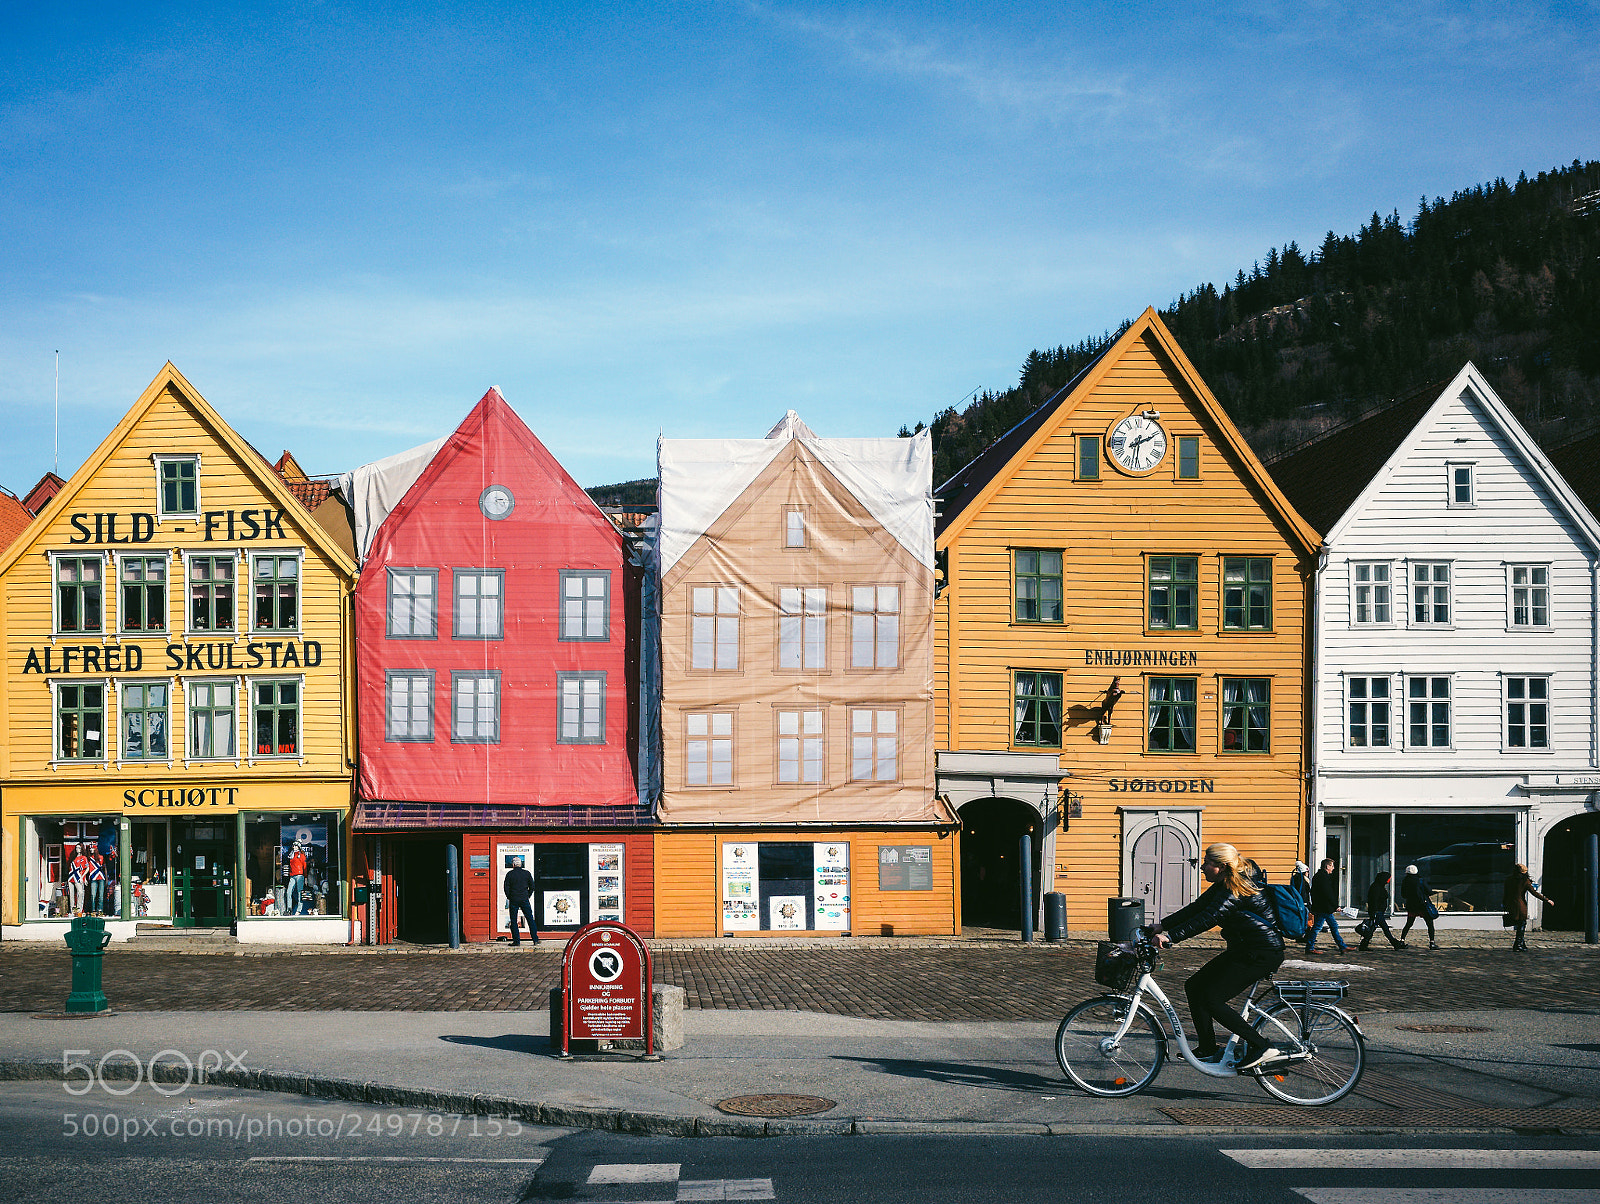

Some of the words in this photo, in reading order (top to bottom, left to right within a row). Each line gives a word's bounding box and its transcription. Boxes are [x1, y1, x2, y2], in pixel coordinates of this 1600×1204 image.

[70, 511, 155, 545] SILD
[204, 508, 289, 542] FISK
[22, 644, 144, 675] ALFRED
[165, 640, 323, 672] SKULSTAD
[1084, 648, 1199, 667] ENHJØRNINGEN
[1108, 778, 1215, 794] SJØBODEN
[1573, 776, 1600, 785] STENS
[123, 787, 240, 808] SCHJØTT
